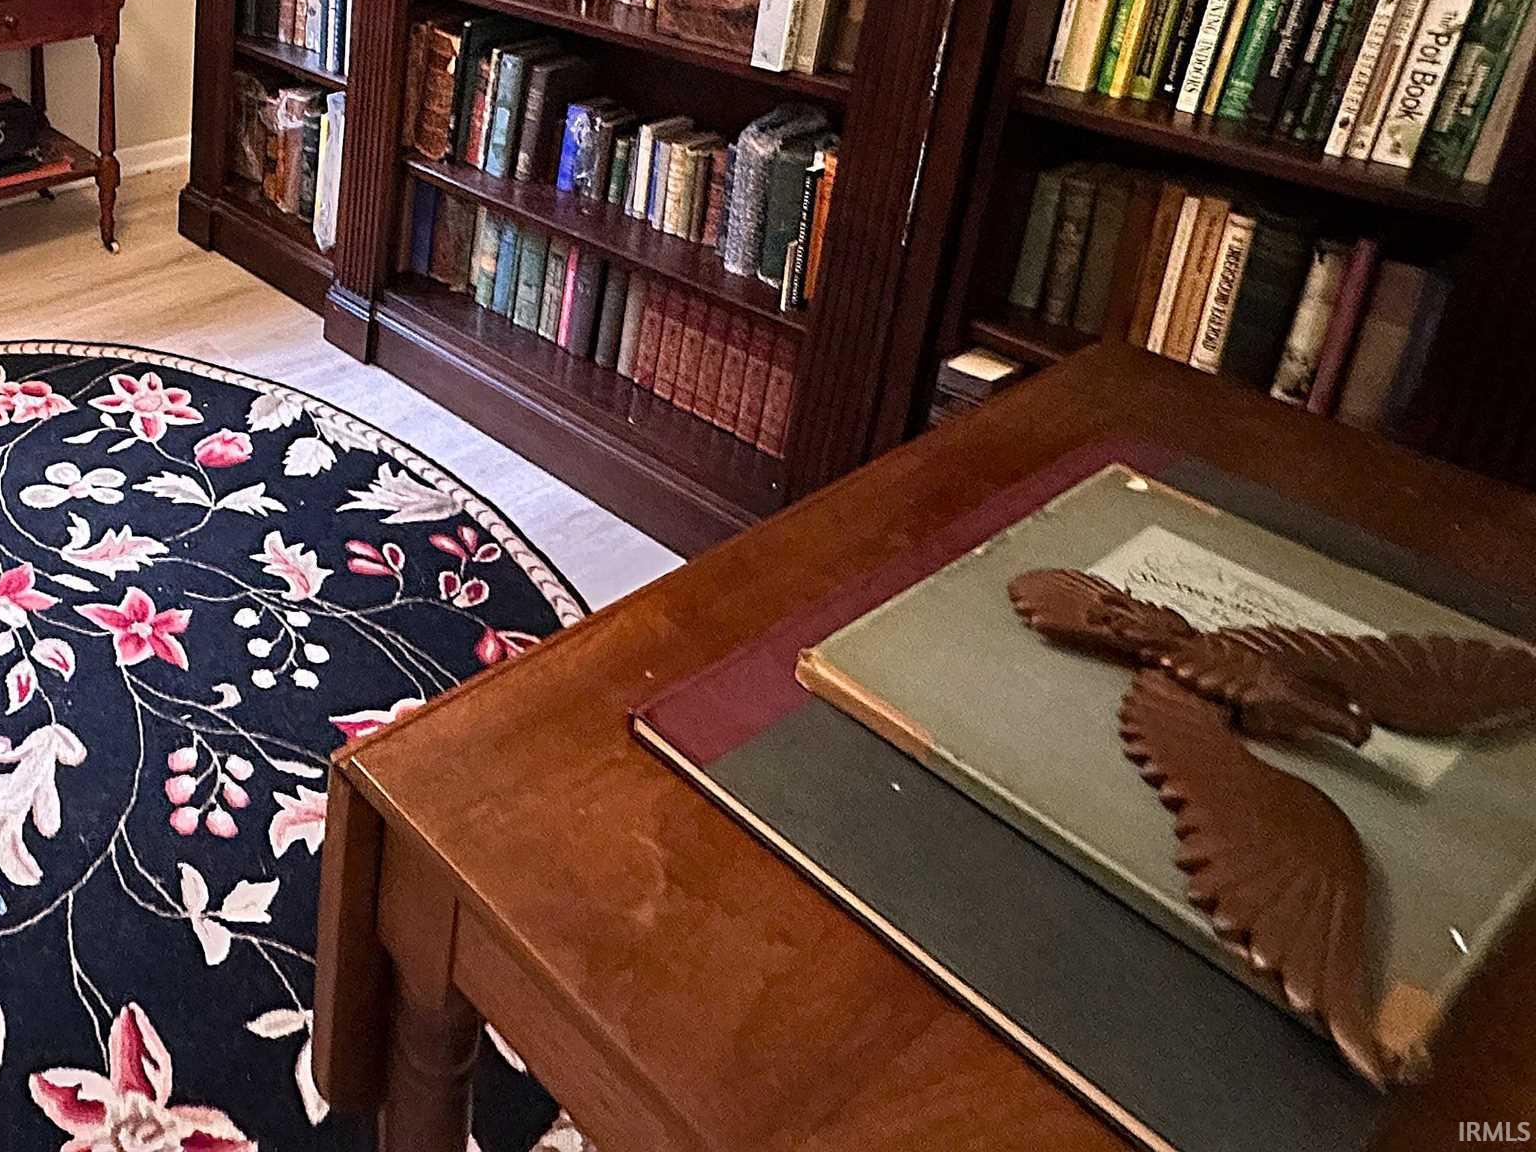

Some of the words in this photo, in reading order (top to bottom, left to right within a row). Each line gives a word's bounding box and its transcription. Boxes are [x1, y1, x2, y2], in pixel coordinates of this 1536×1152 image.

[1184, 39, 1213, 95] INDOORS
[1418, 31, 1453, 65] Pot
[1398, 70, 1438, 121] Book
